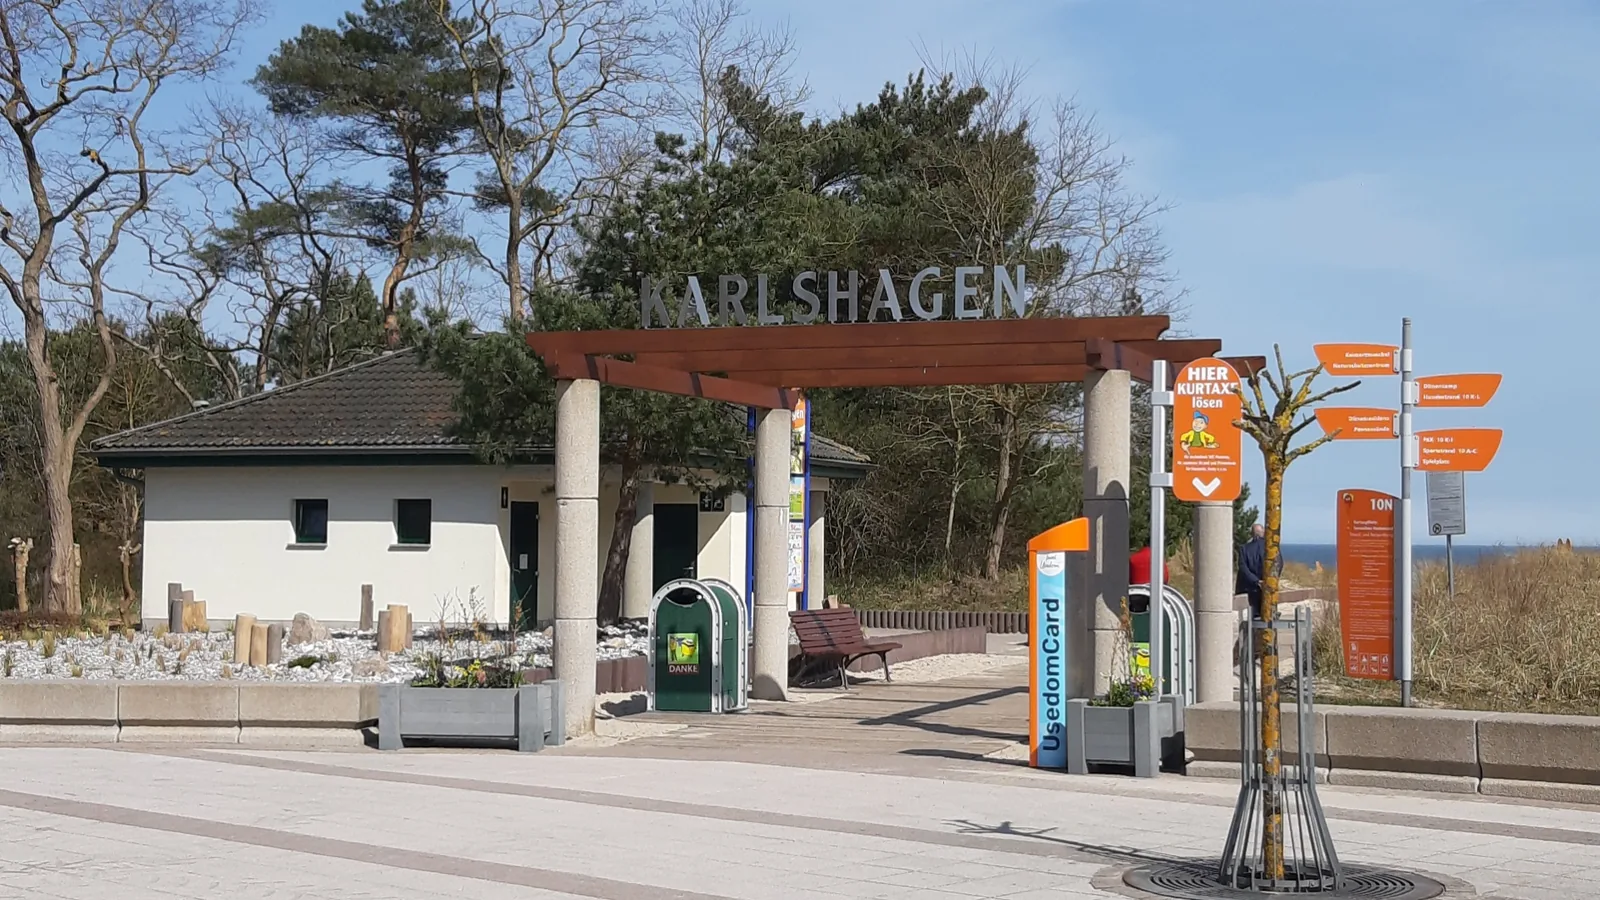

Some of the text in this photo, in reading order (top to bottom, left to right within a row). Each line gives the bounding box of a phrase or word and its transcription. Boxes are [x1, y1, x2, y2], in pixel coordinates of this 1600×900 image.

[641, 265, 1026, 328] KARLSHAGEN
[1187, 366, 1228, 380] HIER
[1192, 396, 1223, 408] lösen
[1370, 498, 1393, 511] 10N
[668, 664, 698, 673] DANKE
[1042, 598, 1060, 751] UsedomCard
